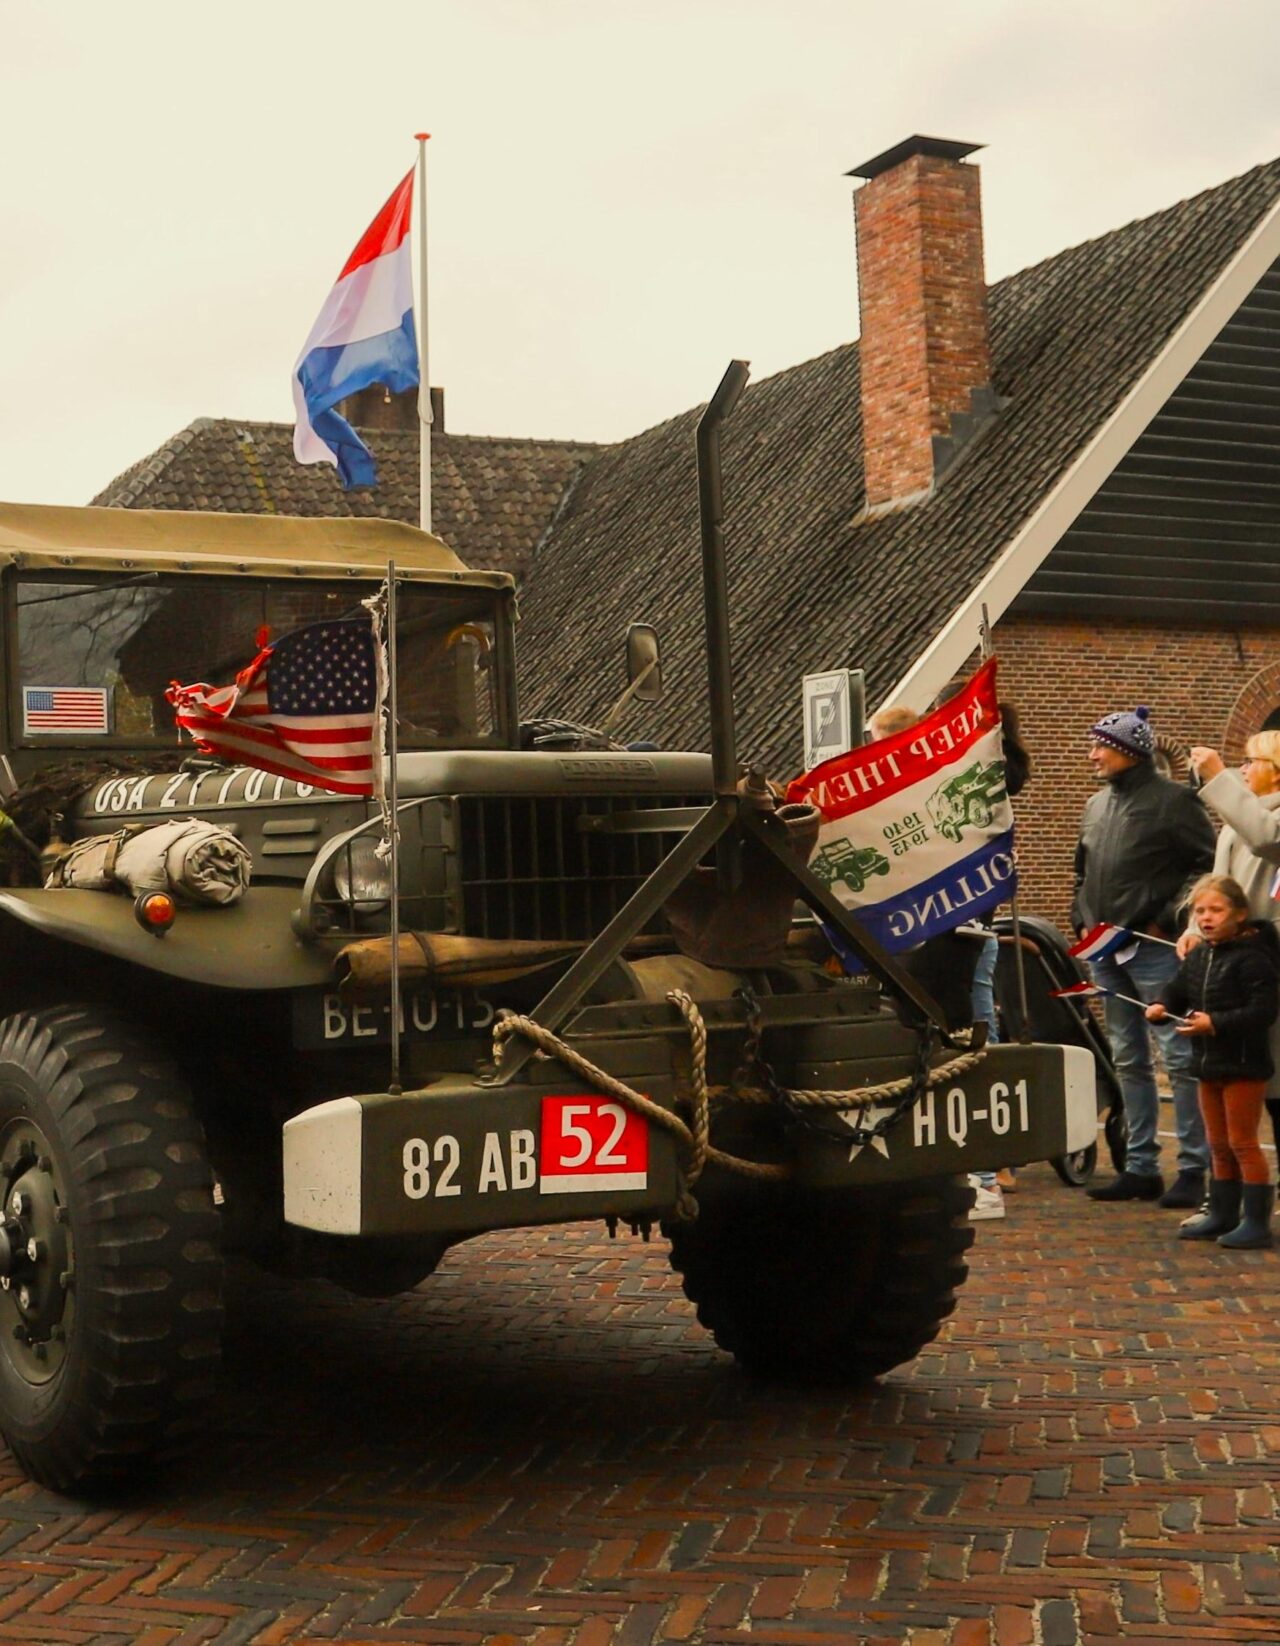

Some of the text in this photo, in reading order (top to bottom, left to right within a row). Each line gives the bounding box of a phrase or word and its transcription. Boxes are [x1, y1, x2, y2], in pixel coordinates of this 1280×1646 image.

[94, 775, 155, 812] USA
[572, 760, 650, 776] DODGE
[559, 1103, 627, 1168] 52
[913, 1079, 1029, 1148] HQ-61
[402, 1128, 536, 1200] 82 AB
